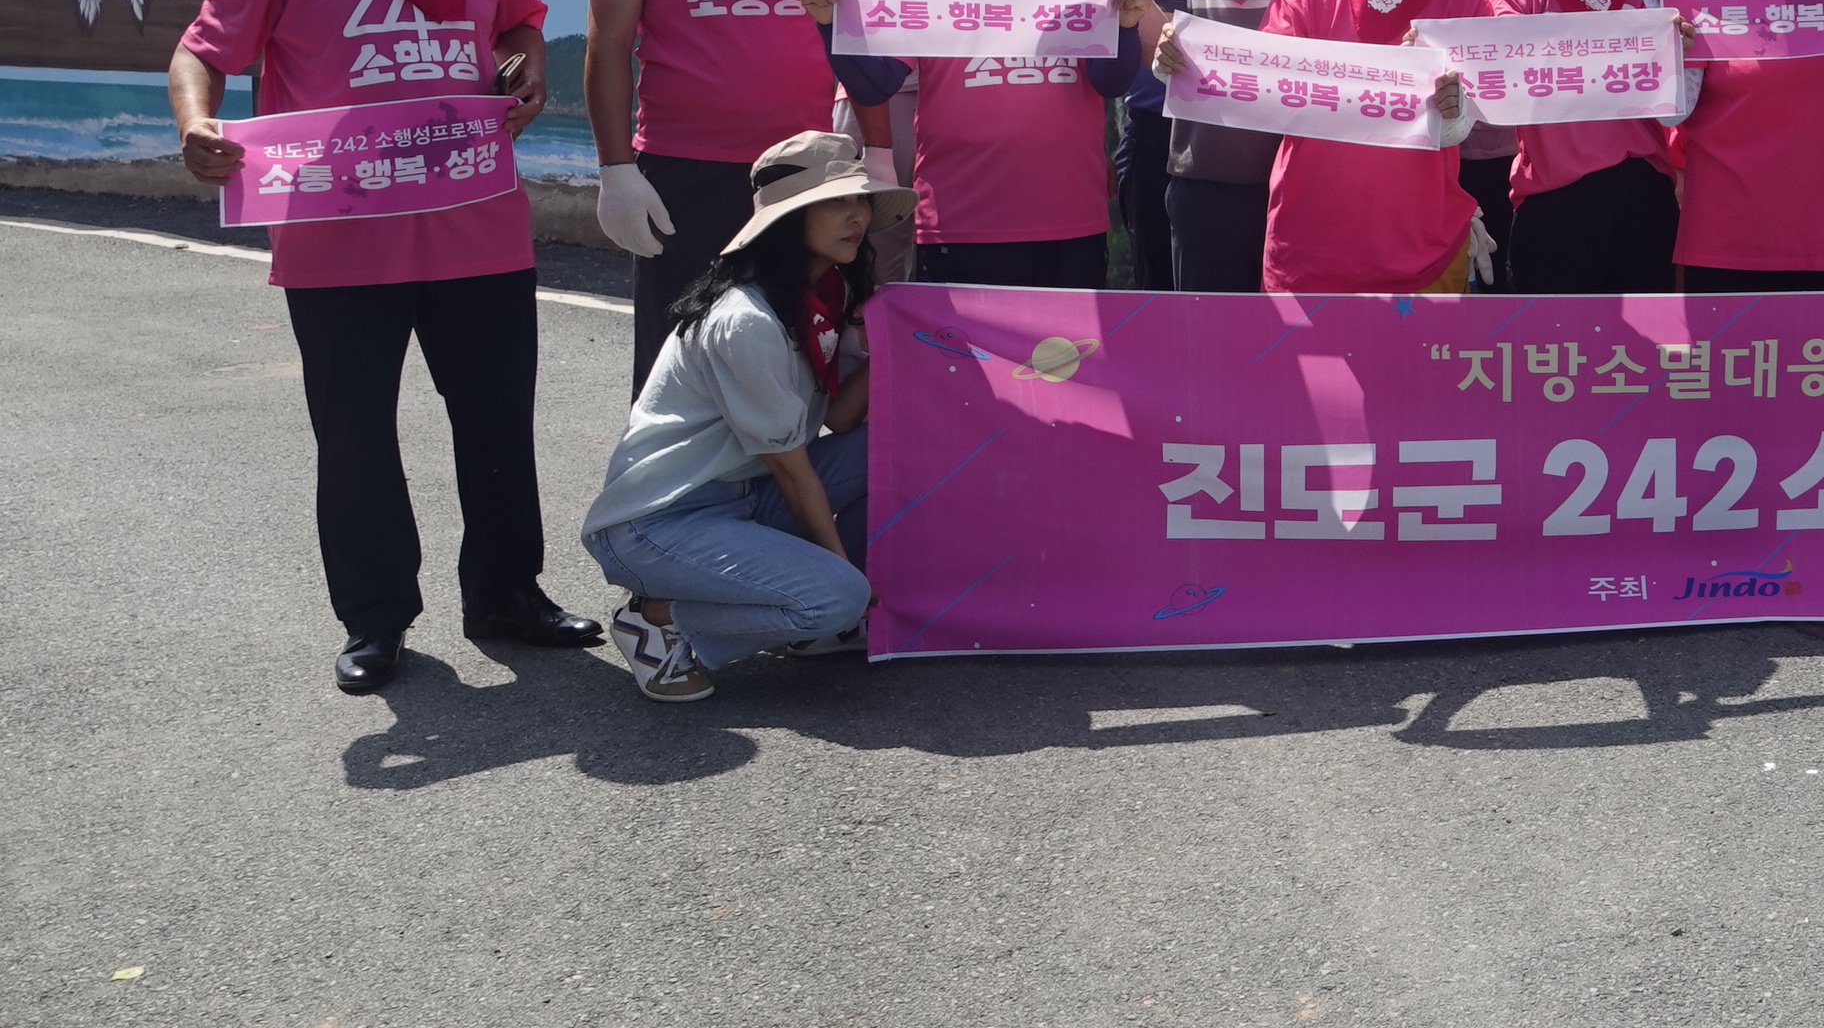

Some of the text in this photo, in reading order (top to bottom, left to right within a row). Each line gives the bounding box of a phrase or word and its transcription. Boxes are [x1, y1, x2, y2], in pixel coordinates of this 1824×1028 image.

[349, 39, 479, 88] 소행성
[1203, 44, 1415, 87] 진도군 242 소행성프로젝트
[1449, 36, 1656, 62] 진도군 242 소행성프로젝트
[263, 118, 499, 159] 진도군 242 소행성프로젝트
[1158, 438, 1502, 541] 진도군
[1588, 574, 1648, 601] 주최
[1673, 576, 1781, 600] Jindo
